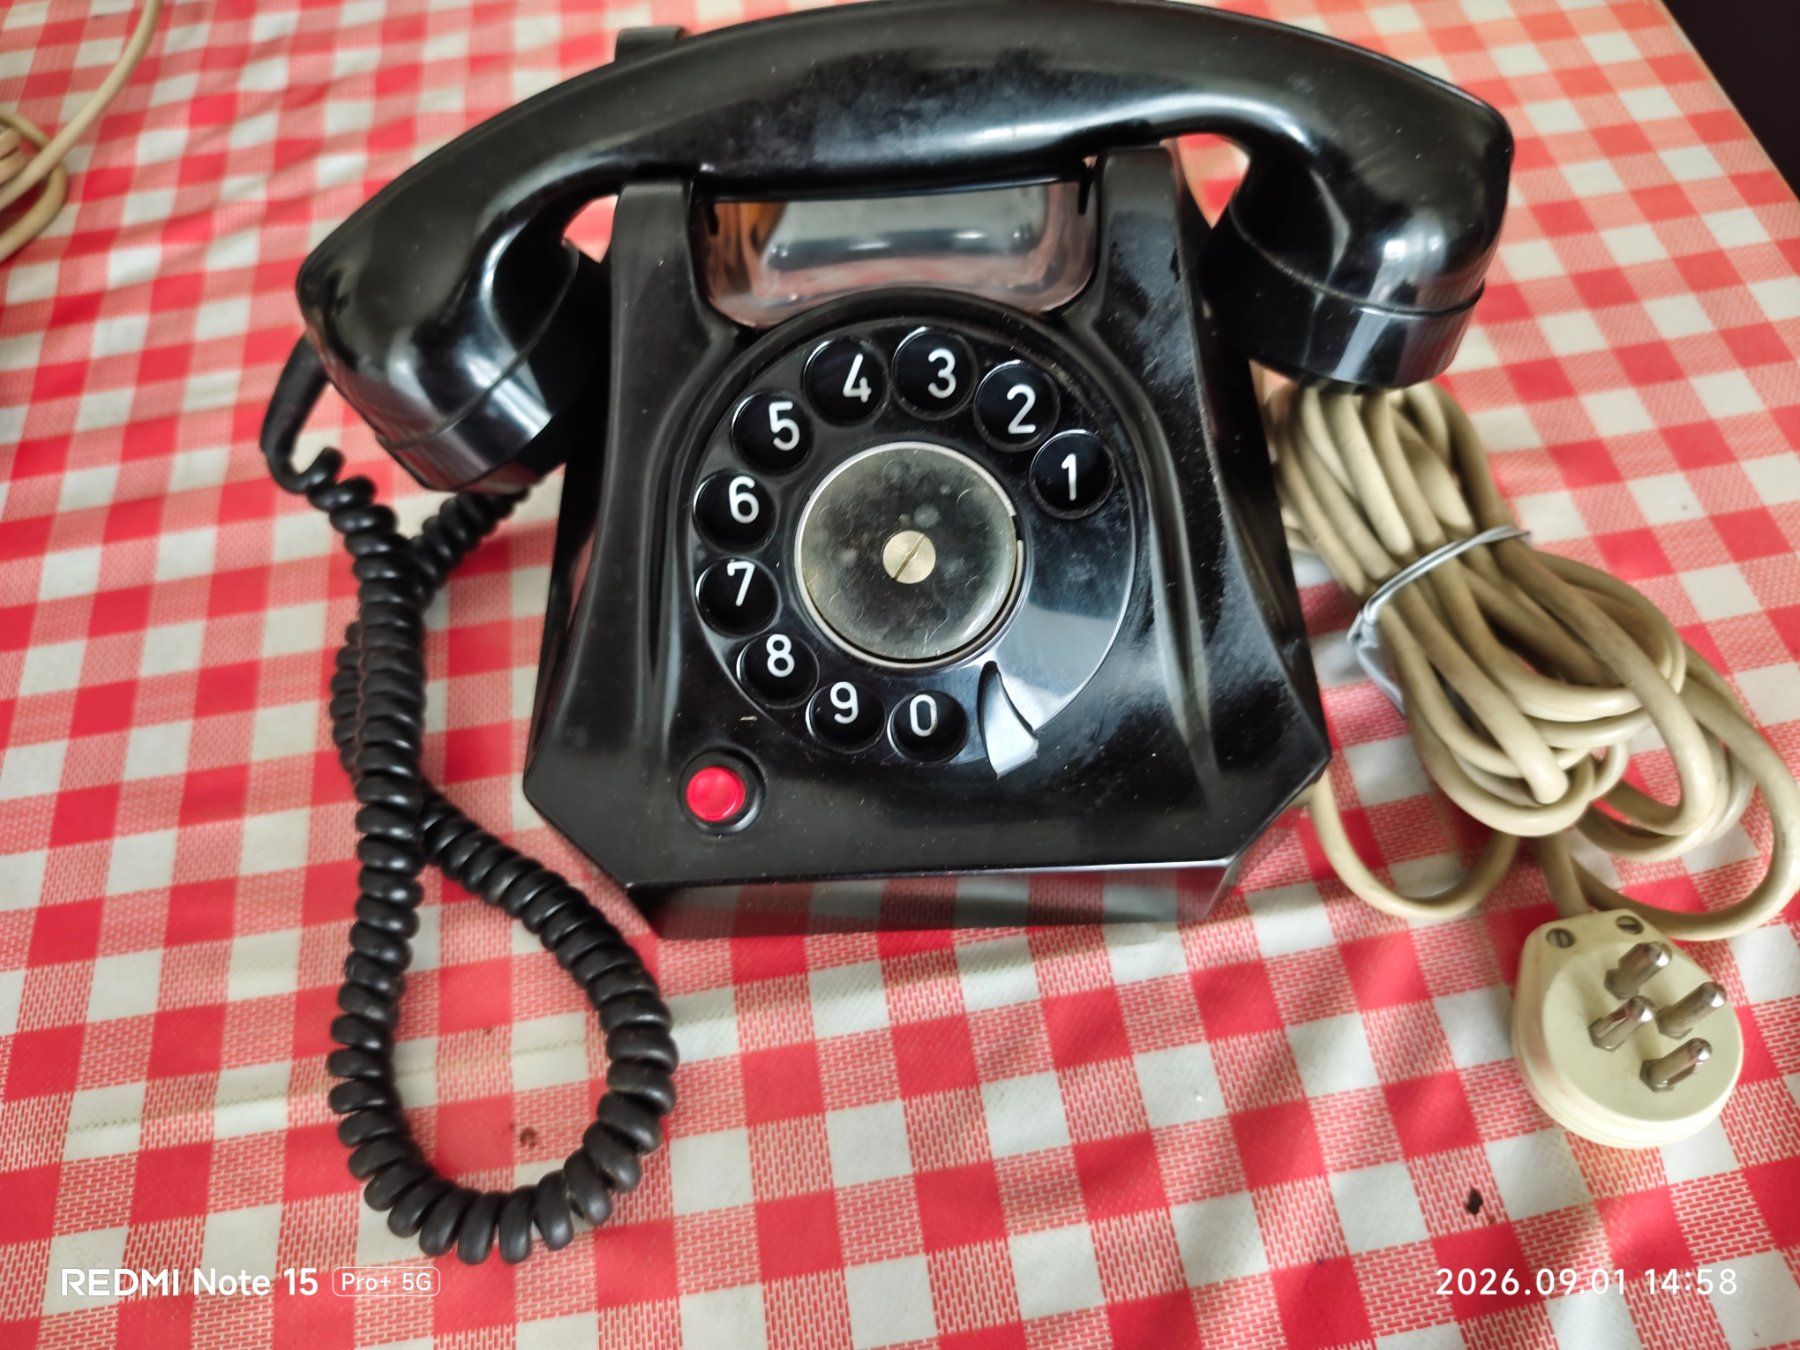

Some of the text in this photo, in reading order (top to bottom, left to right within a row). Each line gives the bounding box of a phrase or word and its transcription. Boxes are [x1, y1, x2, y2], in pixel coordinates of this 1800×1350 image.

[842, 353, 872, 403] 4
[927, 347, 957, 398] 3
[768, 400, 800, 451] 5
[1006, 383, 1037, 434] 2
[728, 475, 759, 524] 6
[1060, 453, 1077, 501] 1
[726, 559, 756, 607] 7
[765, 633, 795, 678] 8
[829, 681, 859, 724] 9
[909, 693, 938, 737] 0
